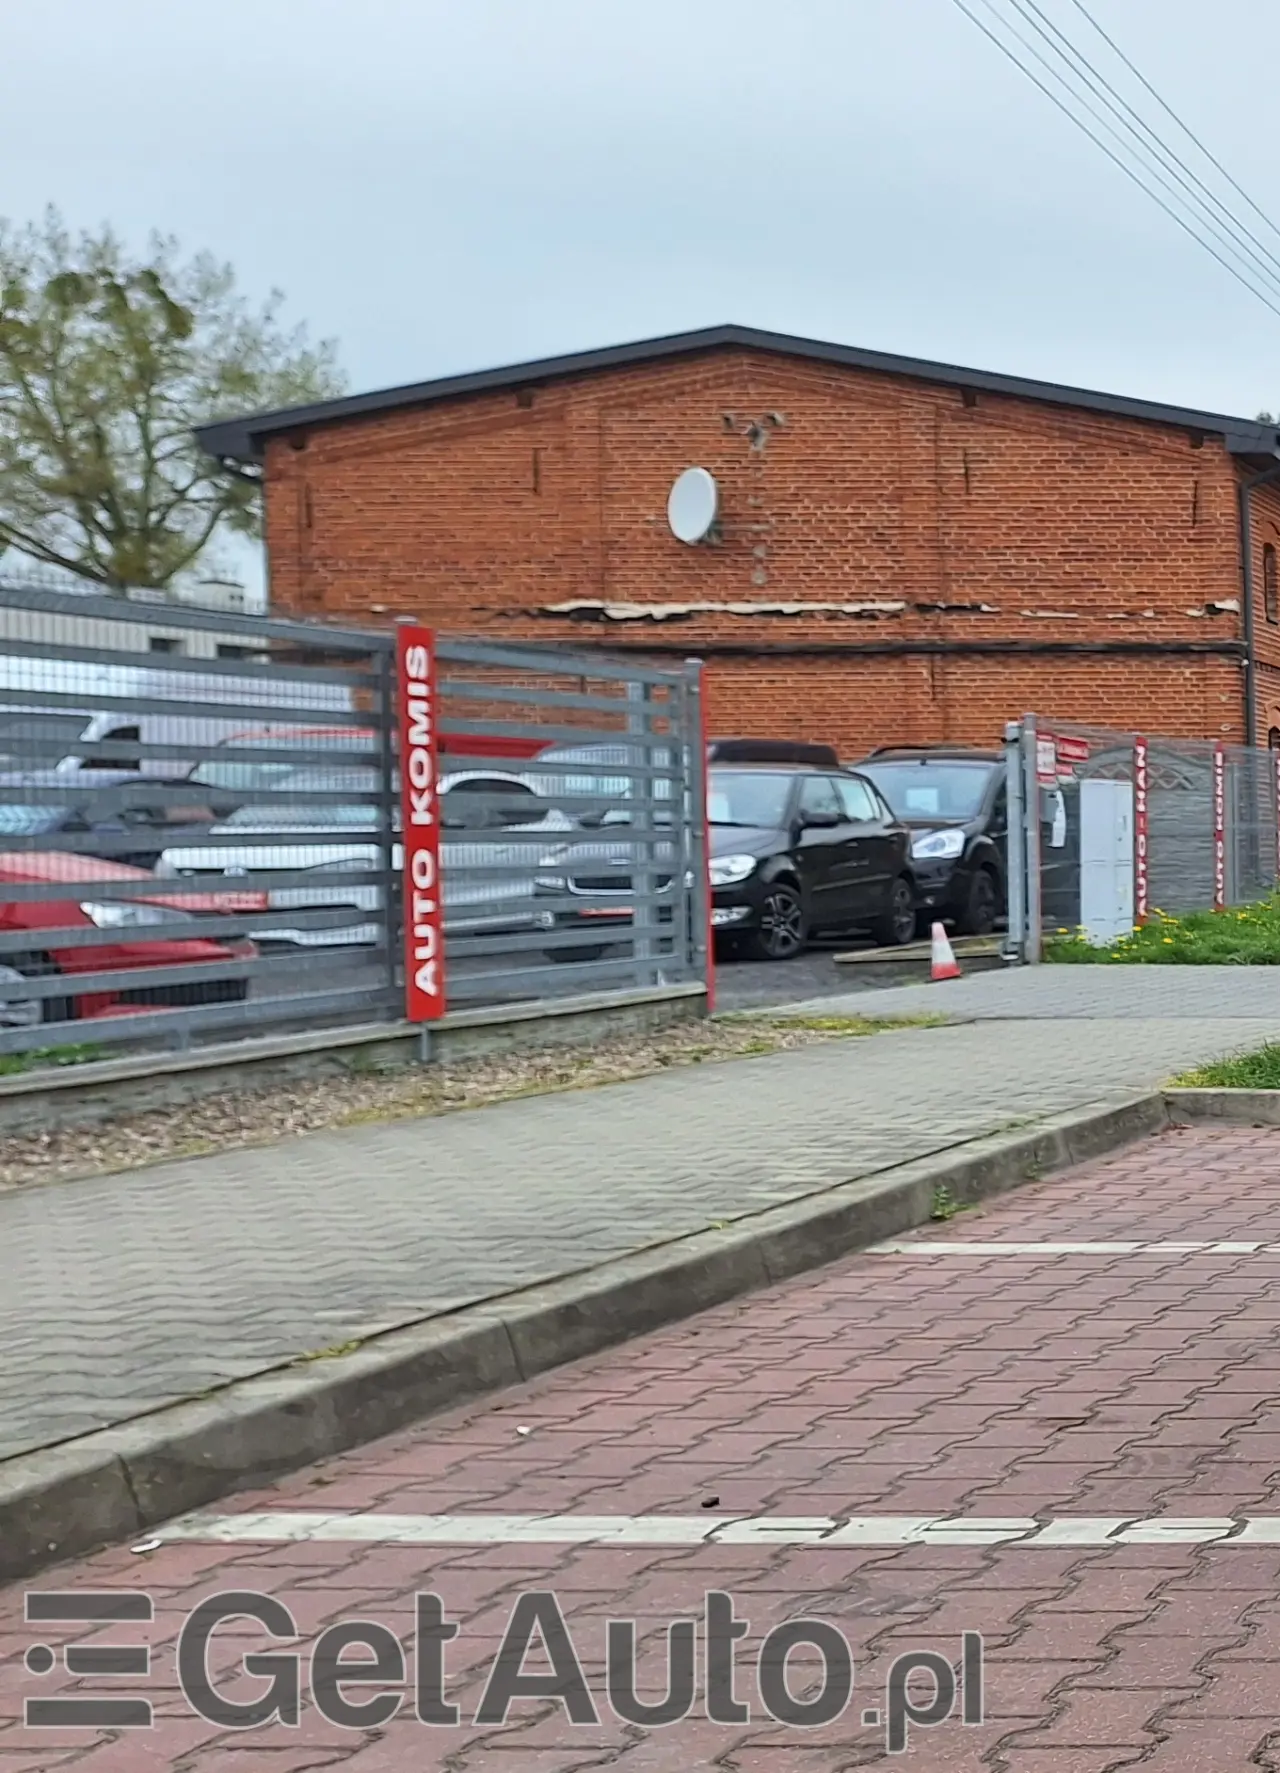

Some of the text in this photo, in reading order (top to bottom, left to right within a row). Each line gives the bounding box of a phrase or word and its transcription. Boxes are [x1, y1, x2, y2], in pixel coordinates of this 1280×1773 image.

[405, 644, 438, 997] AUTO KOMIS
[1215, 840, 1224, 905] AUTO
